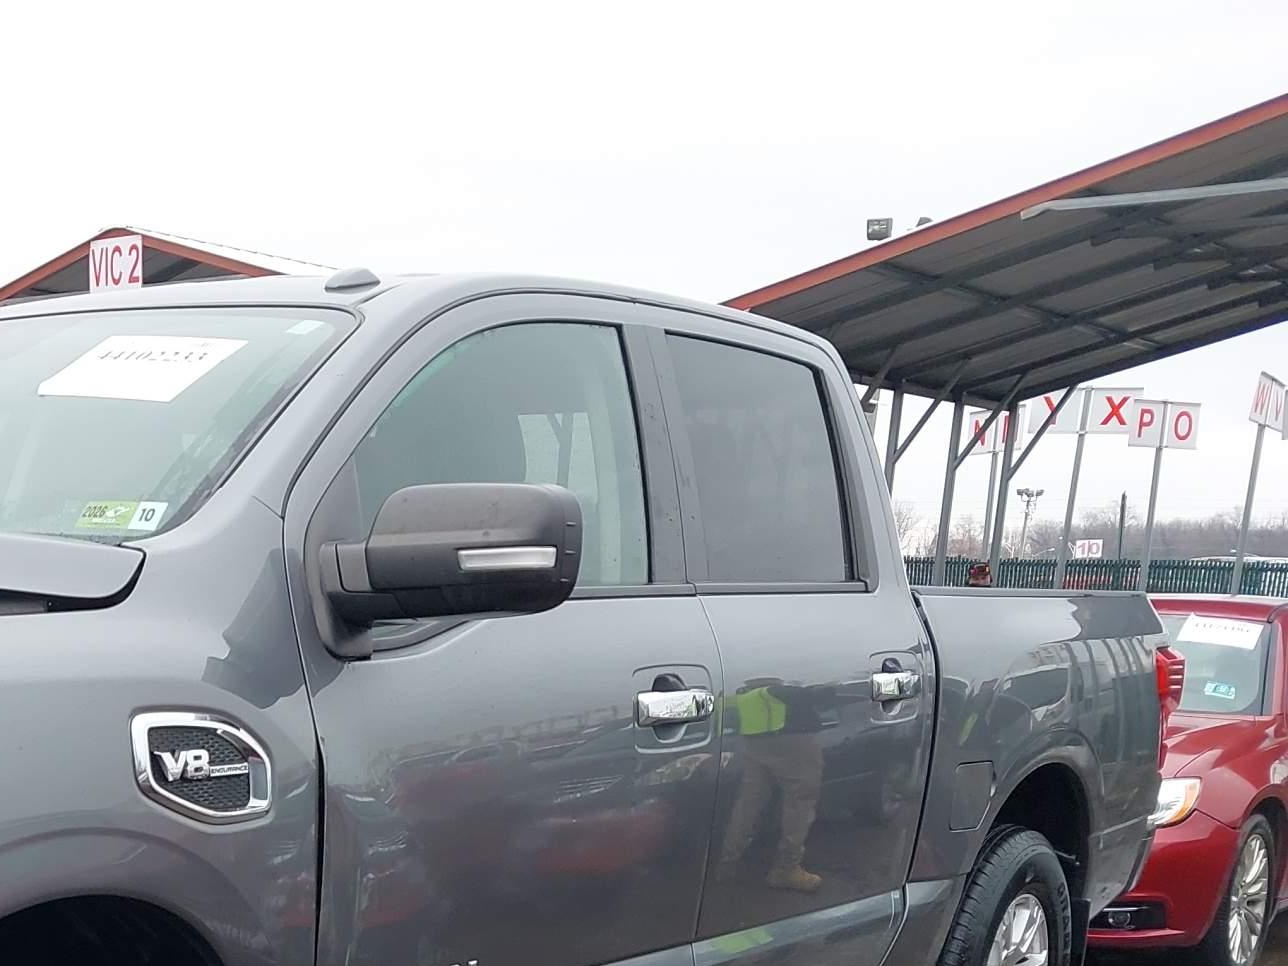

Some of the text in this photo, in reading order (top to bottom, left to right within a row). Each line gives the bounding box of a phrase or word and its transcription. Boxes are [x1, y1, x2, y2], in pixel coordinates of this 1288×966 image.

[91, 243, 140, 287] VIC 2
[1099, 396, 1131, 426] X
[1137, 408, 1193, 441] P O
[138, 507, 156, 522] 10
[1077, 542, 1101, 555] 10
[153, 748, 210, 782] V8
